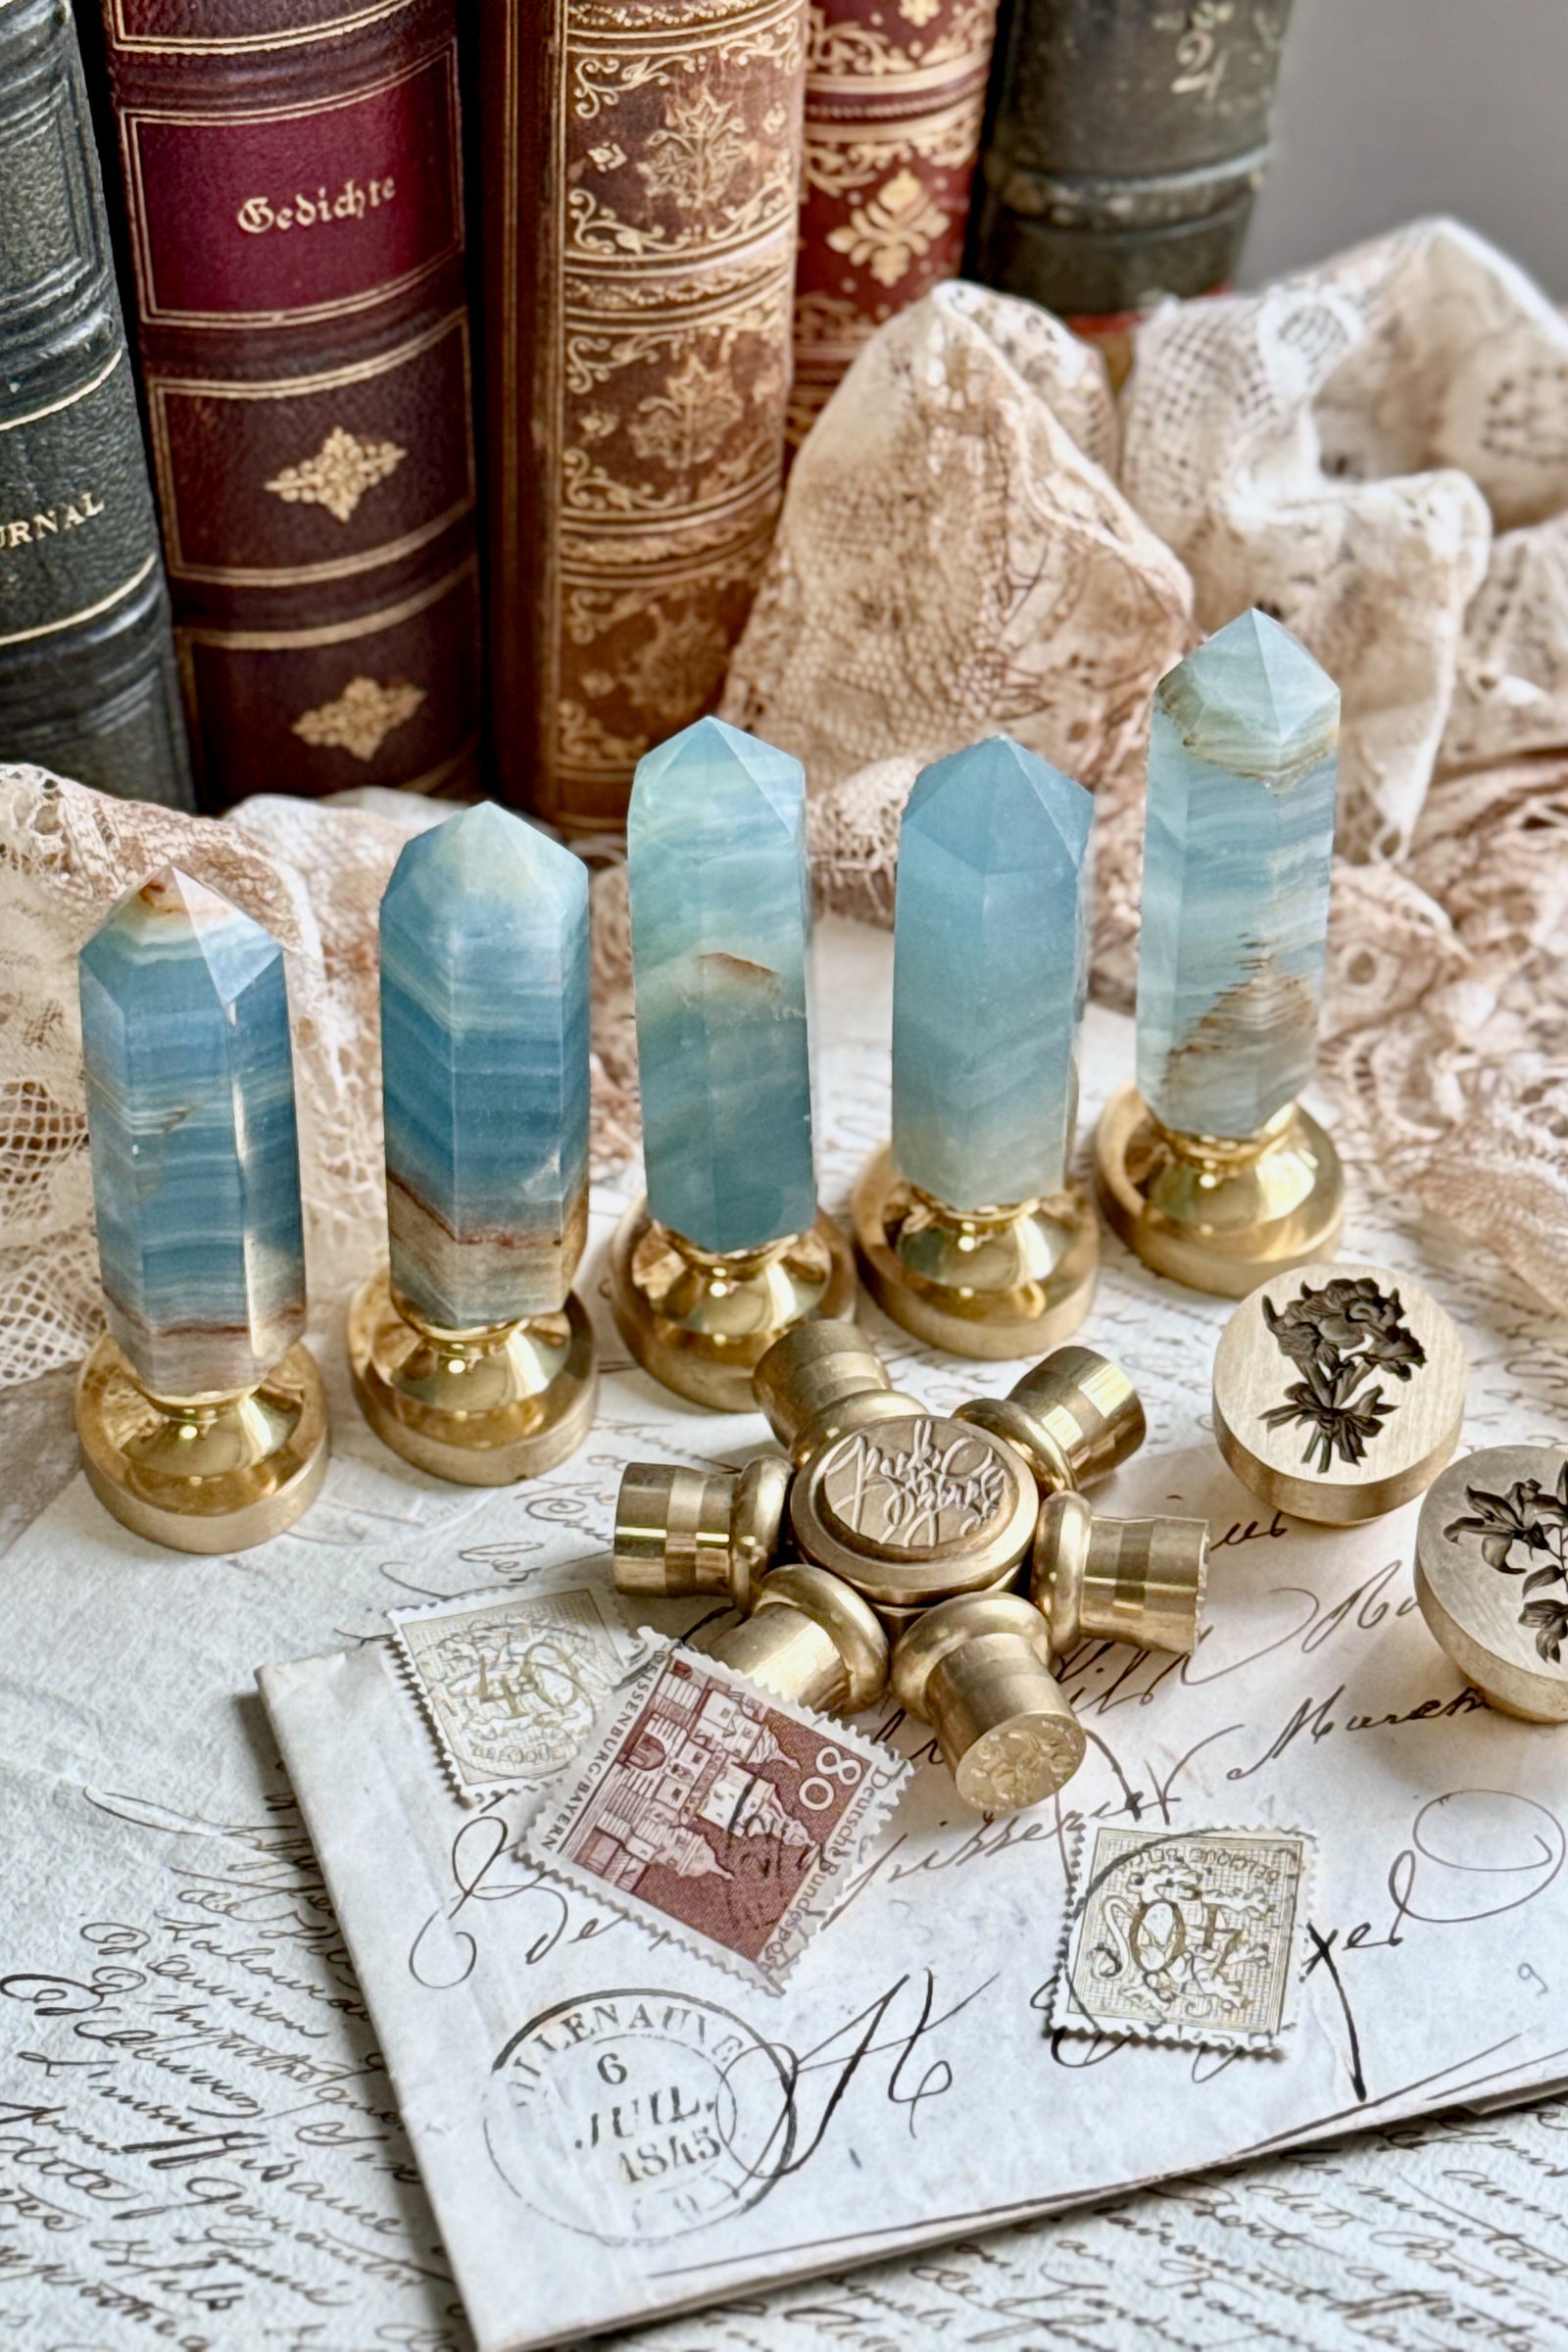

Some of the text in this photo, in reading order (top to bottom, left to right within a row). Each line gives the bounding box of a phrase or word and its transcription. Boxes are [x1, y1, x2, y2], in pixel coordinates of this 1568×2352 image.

[237, 176, 396, 233] Gedichte
[0, 492, 105, 548] RNAL
[799, 1745, 861, 1812] 80
[597, 2053, 627, 2085] 6
[618, 2126, 722, 2184] 1845
